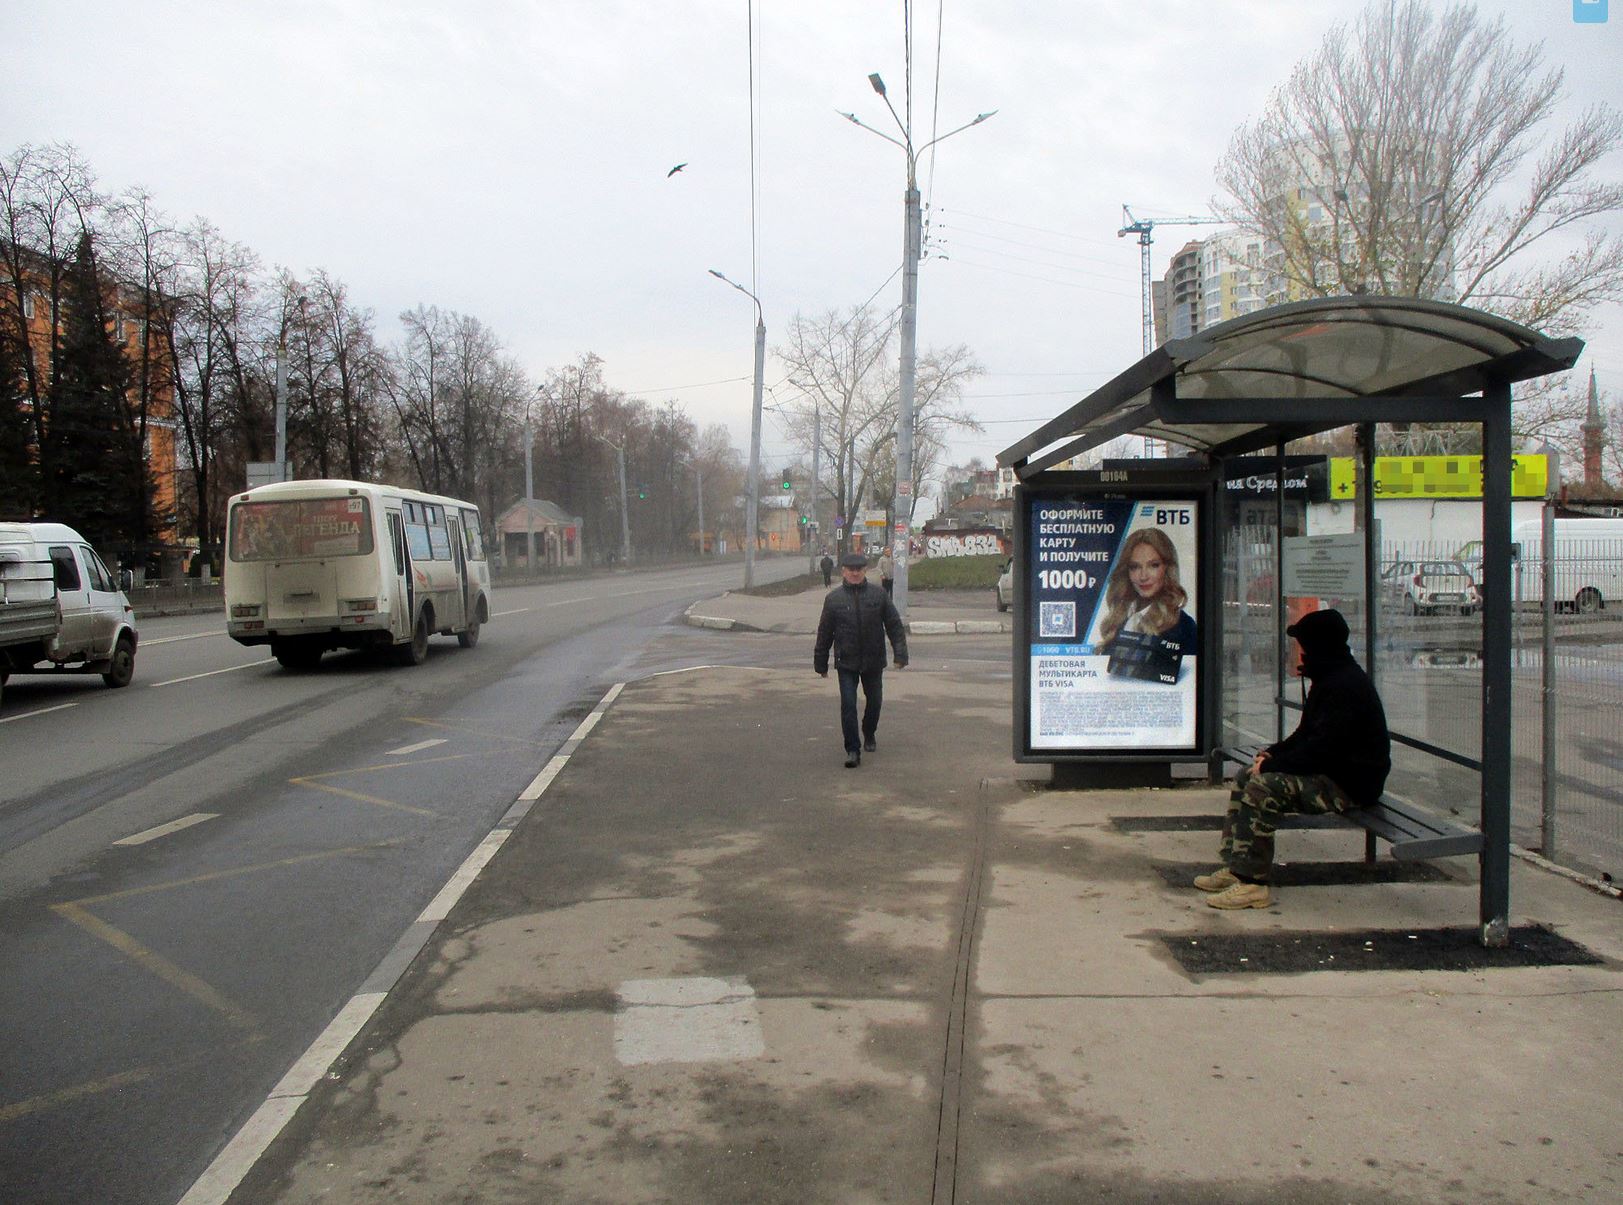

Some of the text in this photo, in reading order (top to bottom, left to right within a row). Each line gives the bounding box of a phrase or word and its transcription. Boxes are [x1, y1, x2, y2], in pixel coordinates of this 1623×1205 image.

[1040, 508, 1103, 520] ОФОРМИТЕ
[1156, 509, 1190, 525] ВТБ
[1040, 523, 1115, 534] БЕСПЛАТНУЮ
[1040, 537, 1076, 548] КАРТУ
[1040, 552, 1109, 562] И ПОЛУЧИТЕ
[1039, 660, 1086, 669] ДЕБЕТОВАЯ
[1039, 670, 1098, 678] МУЛЬТИКАРТА
[1160, 674, 1176, 682] VISA
[1039, 680, 1074, 688] ВТБ VISA
